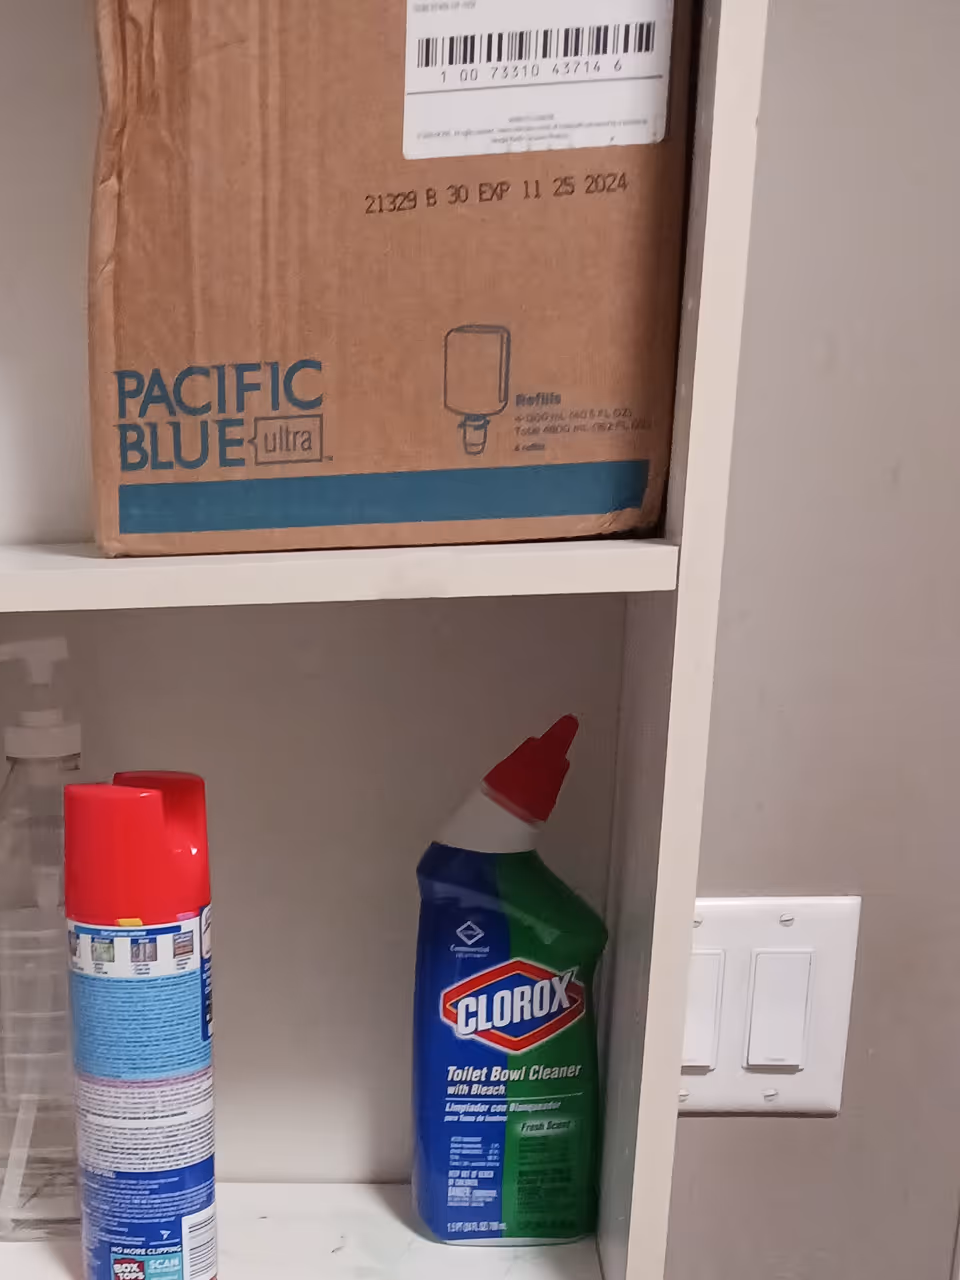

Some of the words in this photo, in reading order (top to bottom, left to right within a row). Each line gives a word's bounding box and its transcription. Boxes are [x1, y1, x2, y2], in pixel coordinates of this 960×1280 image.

[440, 71, 447, 83] 1
[460, 68, 479, 82] 00
[490, 64, 540, 80] 73310
[552, 60, 601, 75] 43714
[614, 58, 622, 72] 6
[365, 191, 418, 214] 21329
[426, 187, 437, 208] B
[446, 184, 468, 205] 30
[478, 181, 511, 203] EXP
[523, 180, 541, 199] 11
[553, 176, 575, 197] 25
[584, 172, 629, 195] 2024
[115, 359, 323, 418] PACIFIC
[116, 418, 246, 471] BLUE
[263, 425, 312, 453] ultra
[457, 972, 571, 1035] CLOROX
[447, 1066, 488, 1081] Toilet
[490, 1066, 526, 1081] Bowl
[529, 1064, 582, 1080] Cleaner
[447, 1084, 468, 1095] with
[471, 1084, 506, 1095] Bleach
[445, 1102, 489, 1113] Limpiador
[521, 1122, 545, 1132] Fresh
[123, 1247, 145, 1255] MORE
[147, 1245, 181, 1255] CLIPPING
[114, 1263, 139, 1273] BOX
[149, 1258, 179, 1269] SCAN
